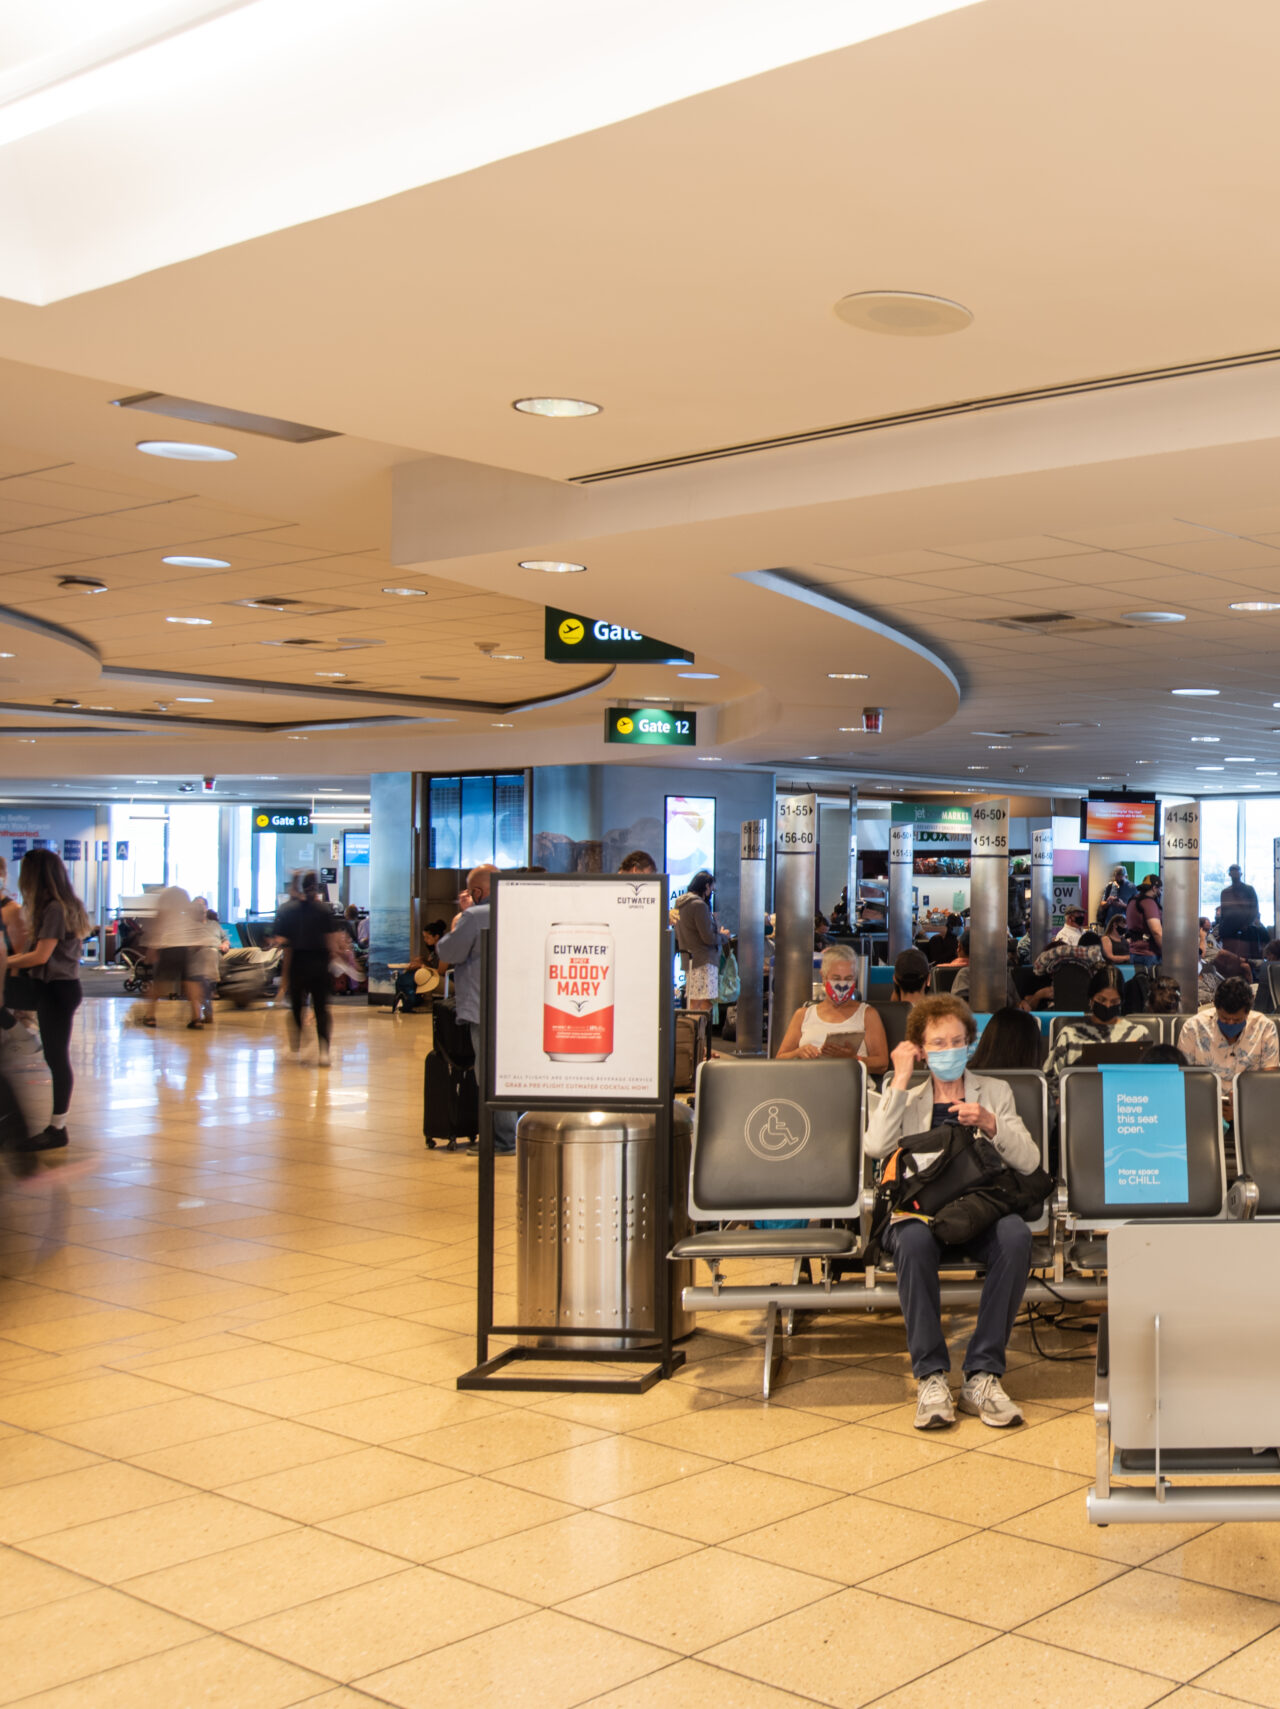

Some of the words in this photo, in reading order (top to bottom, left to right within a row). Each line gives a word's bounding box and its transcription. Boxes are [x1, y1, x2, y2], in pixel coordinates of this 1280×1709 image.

[639, 719, 670, 733] Gate
[676, 720, 690, 734] 12
[780, 804, 808, 816] 51-55
[974, 808, 1001, 820] 46-50
[272, 816, 295, 826] Gate
[298, 816, 308, 826] 13
[1166, 812, 1194, 822] 41-45
[785, 832, 813, 844] 56-60
[980, 836, 1006, 848] 51-55
[1172, 838, 1198, 850] 46-50
[117, 844, 128, 856] A
[1054, 888, 1074, 898] OW
[554, 944, 606, 955] CUTWATER
[549, 965, 610, 980] BLOODY
[557, 981, 600, 996] MARY
[1117, 1094, 1148, 1104] Please
[1117, 1104, 1142, 1114] leave
[1117, 1114, 1135, 1124] this
[1137, 1115, 1158, 1124] seat
[1117, 1126, 1144, 1134] open.
[1138, 1169, 1159, 1177] space
[1128, 1176, 1161, 1185] CHILL.
